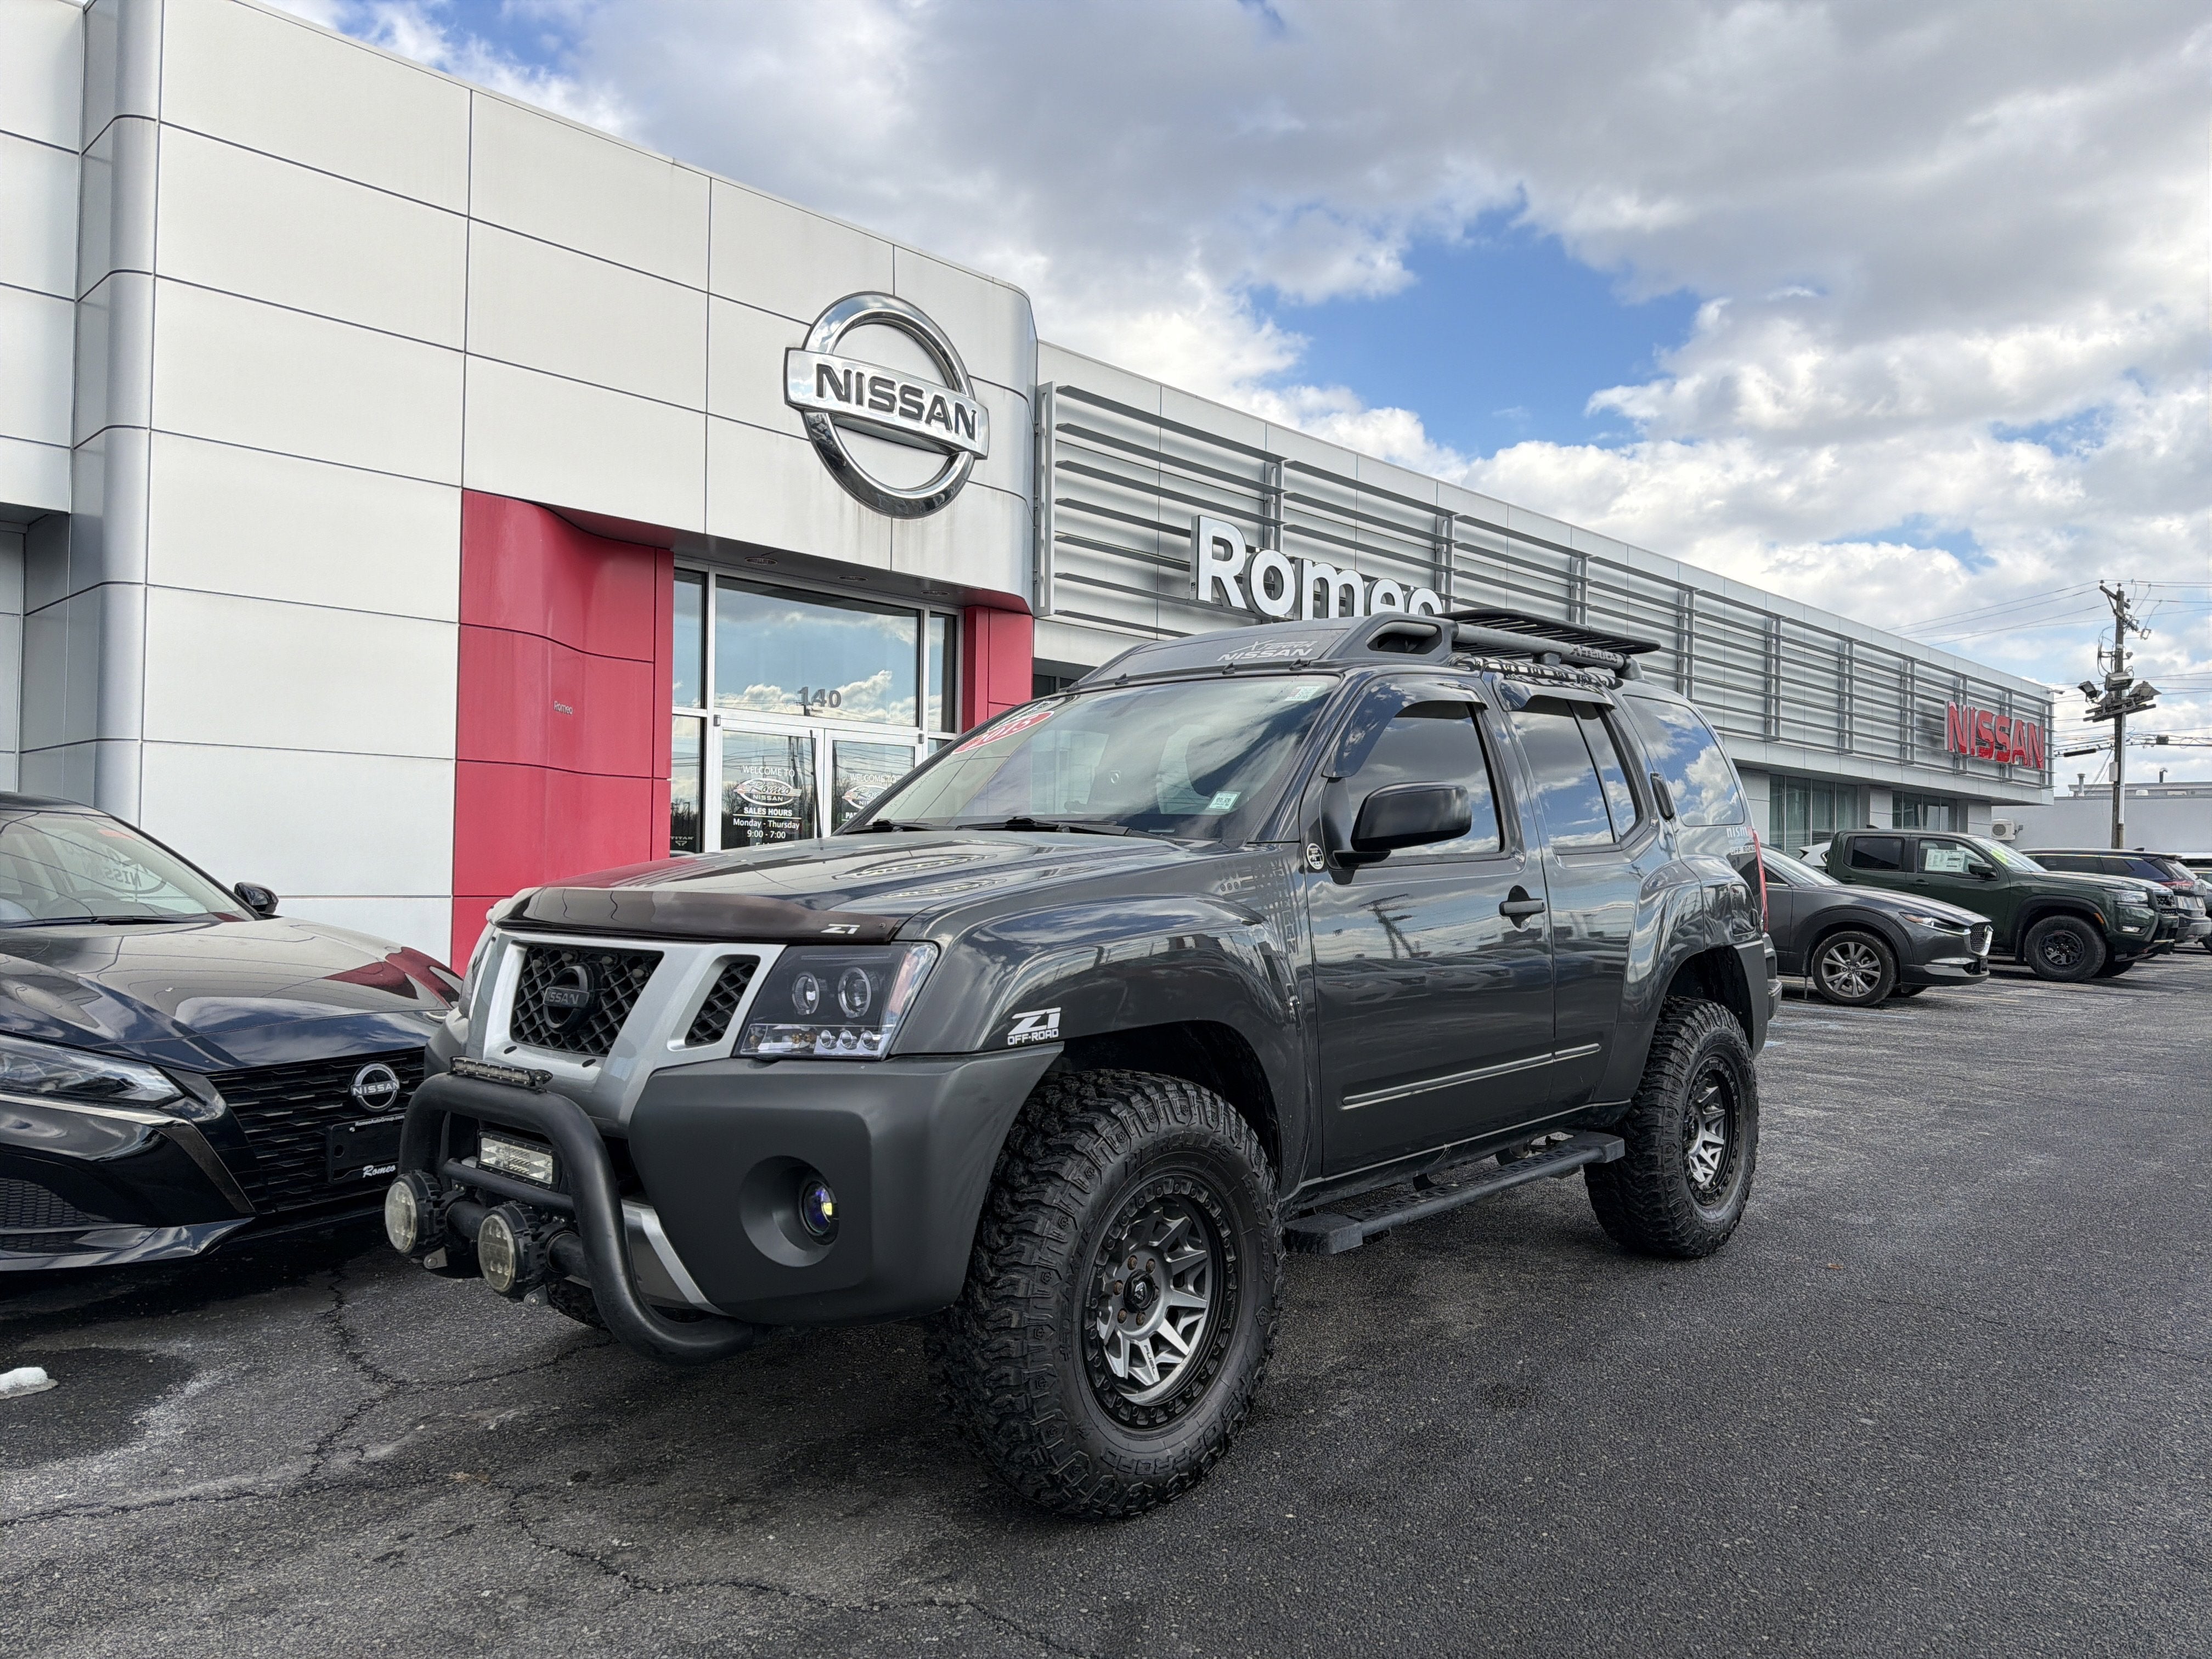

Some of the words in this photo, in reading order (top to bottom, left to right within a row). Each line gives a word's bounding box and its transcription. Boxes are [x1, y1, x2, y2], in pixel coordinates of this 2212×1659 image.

[816, 363, 978, 442] NISSAN
[1190, 515, 1443, 620] Romeo
[1216, 648, 1313, 662] NISSAN
[797, 686, 842, 708] 140
[554, 700, 573, 715] Romeo
[1945, 701, 2044, 770] NISSAN
[743, 765, 782, 776] WELCOME
[785, 768, 795, 777] TO
[850, 774, 885, 783] WELCOME
[747, 779, 791, 794] Romeo
[744, 807, 766, 815] SALES
[733, 818, 762, 828] Monday
[768, 820, 800, 830] Thursday
[821, 923, 861, 934] Z1
[1008, 1007, 1062, 1036] Z1
[1007, 1028, 1059, 1046] OFF-ROAD
[353, 1082, 400, 1096] NISSAN
[355, 1115, 405, 1126] RomeoAutoGroup.com
[363, 1165, 396, 1178] Romeo
